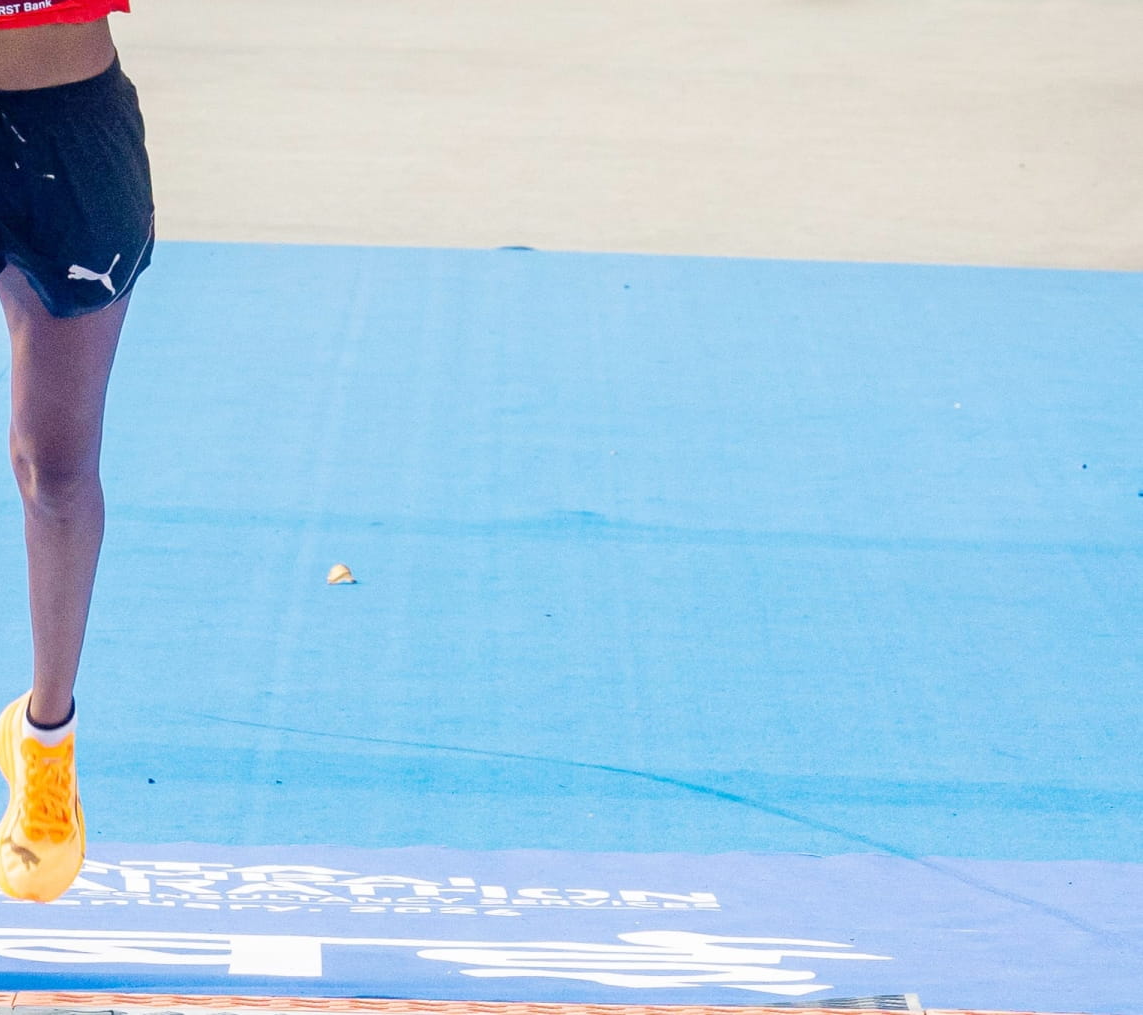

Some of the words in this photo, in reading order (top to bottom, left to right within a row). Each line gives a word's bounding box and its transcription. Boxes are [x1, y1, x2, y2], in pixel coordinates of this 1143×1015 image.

[78, 891, 464, 904] CONSULTANCY
[479, 898, 719, 909] SERVICES
[348, 905, 522, 917] 2026
